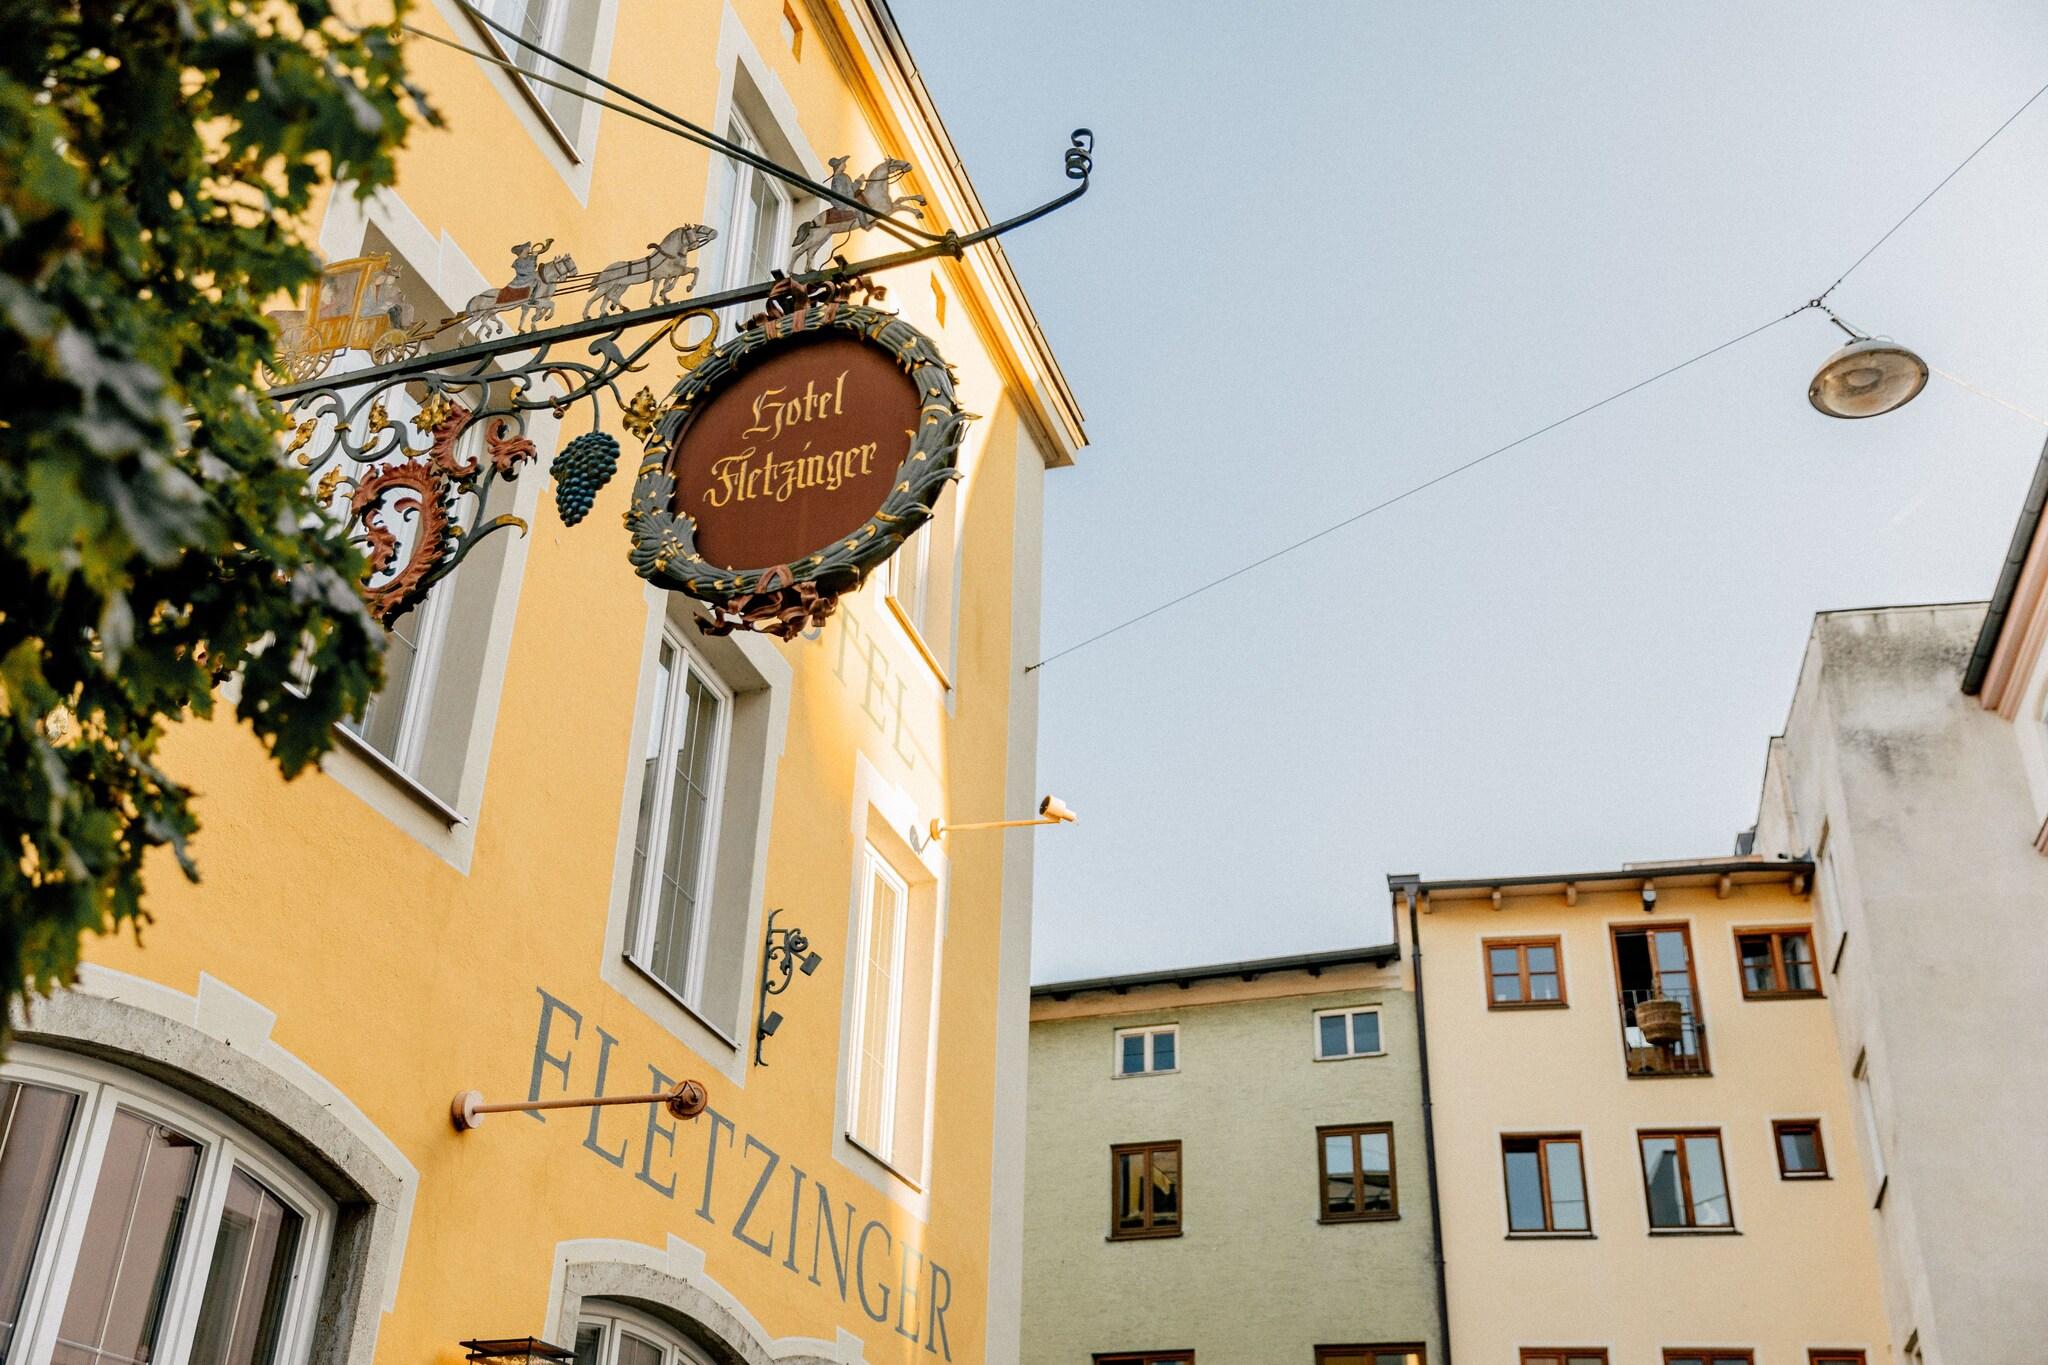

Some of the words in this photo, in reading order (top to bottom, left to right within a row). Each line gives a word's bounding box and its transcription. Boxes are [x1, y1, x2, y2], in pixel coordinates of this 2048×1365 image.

[742, 370, 849, 440] Hotel
[703, 441, 877, 507] Fletzinger
[522, 985, 952, 1362] FLETZINGER
